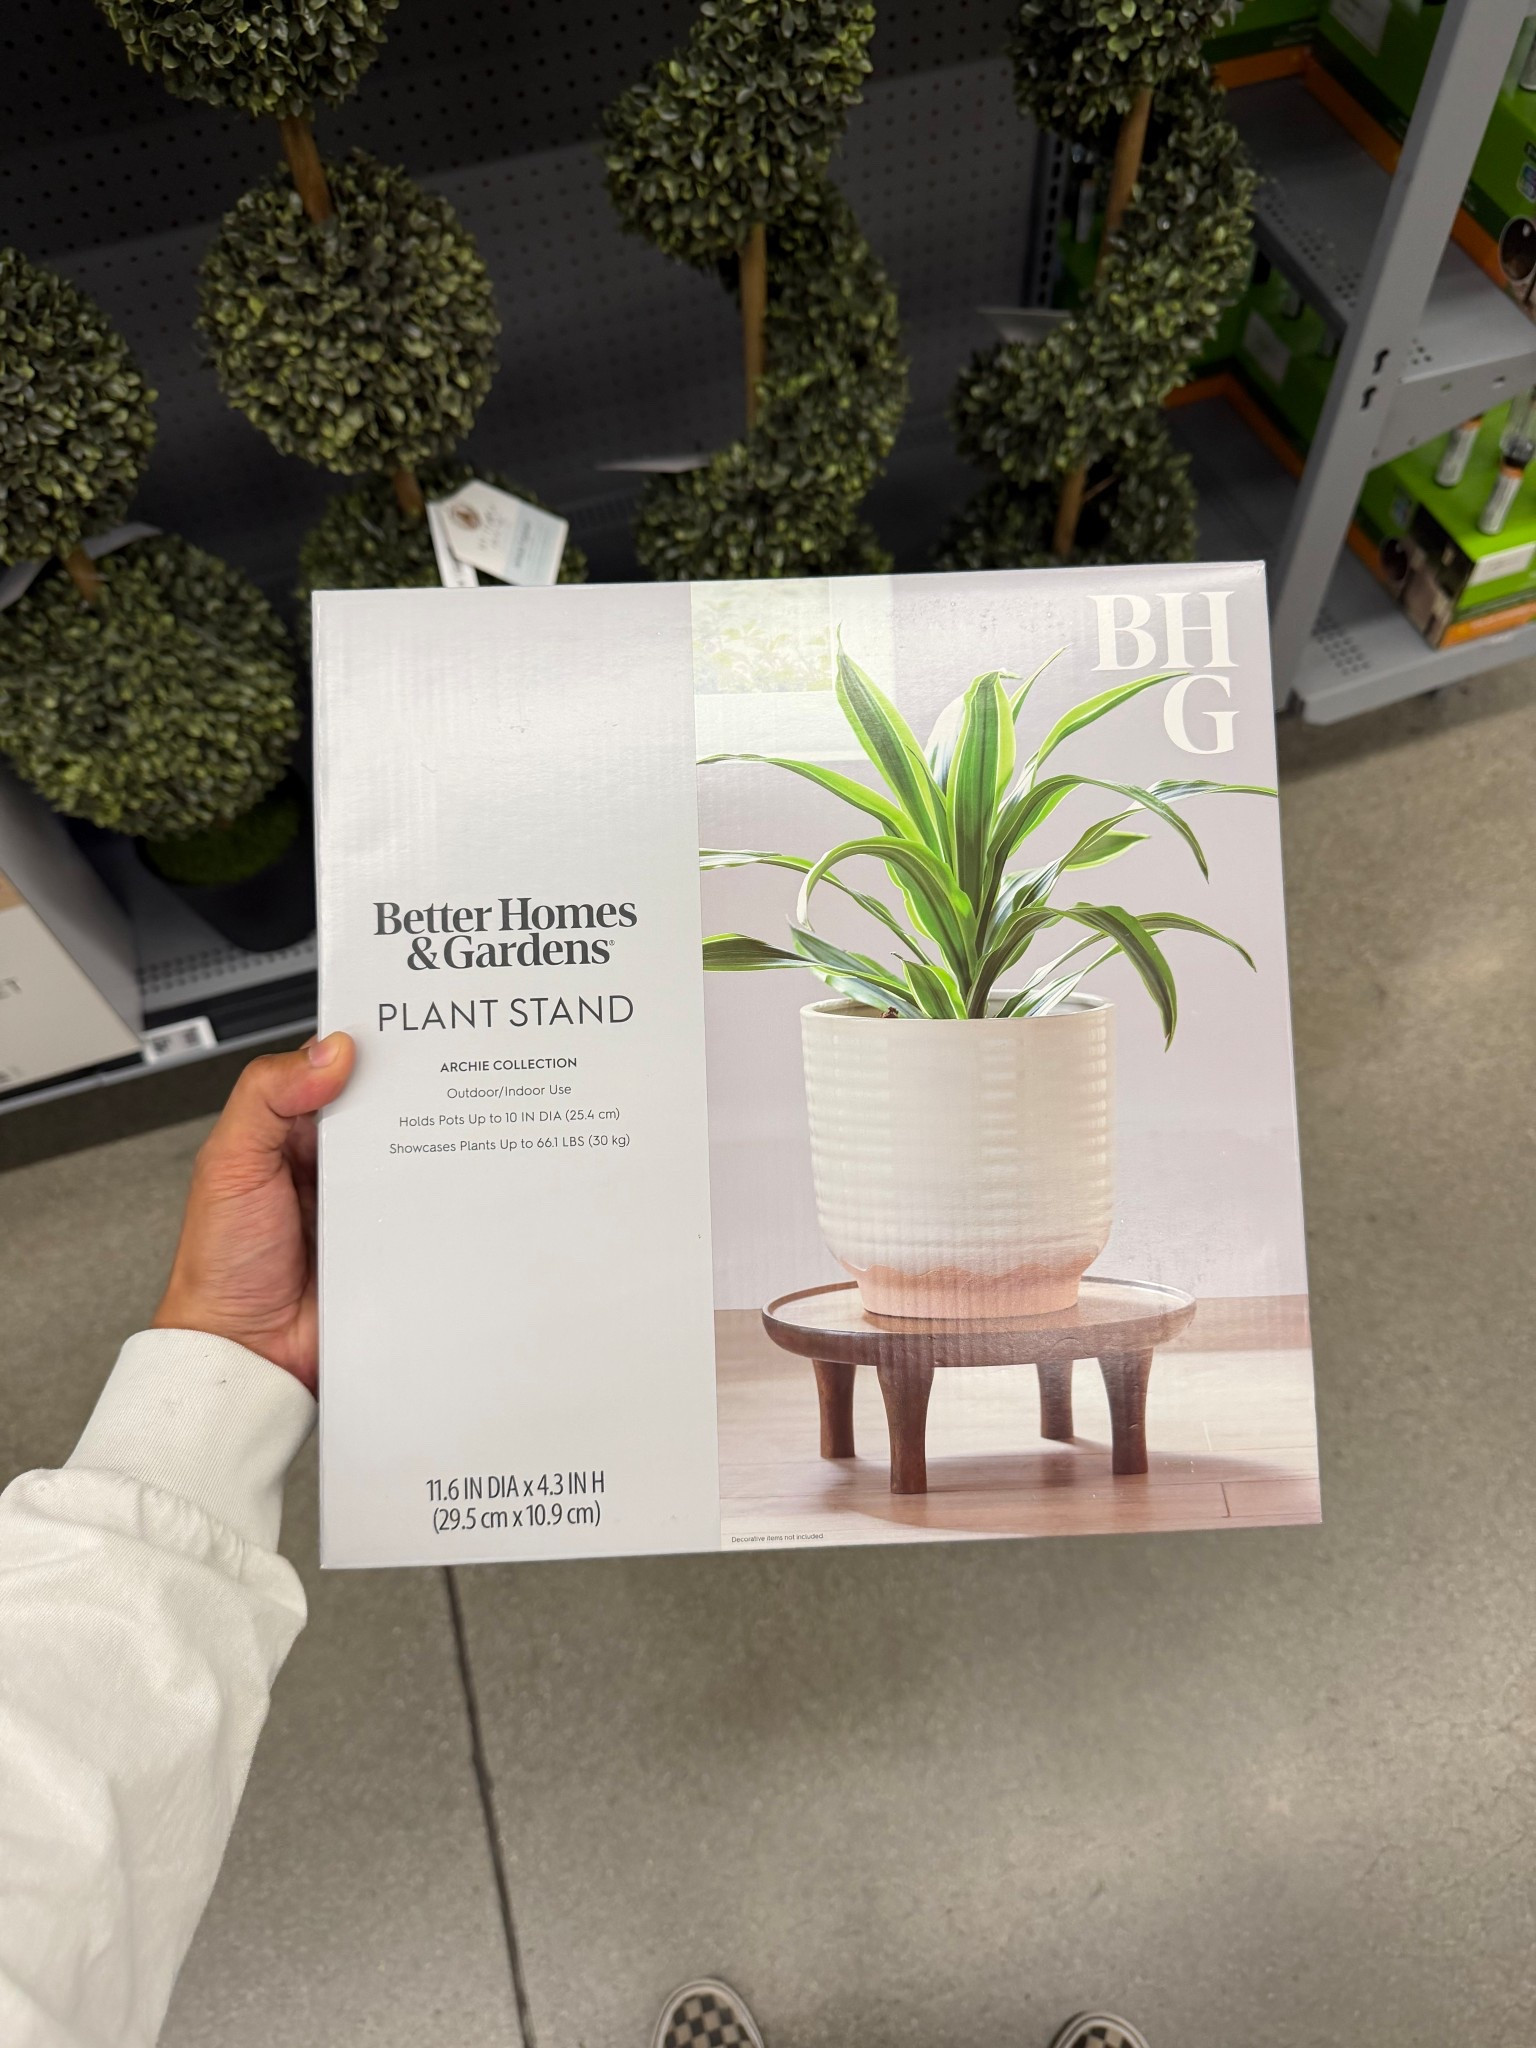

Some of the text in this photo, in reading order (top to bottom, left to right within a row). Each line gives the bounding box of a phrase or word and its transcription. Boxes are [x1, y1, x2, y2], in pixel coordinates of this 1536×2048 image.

[1163, 674, 1240, 755] G
[373, 897, 637, 936] Better Homes
[379, 995, 634, 1031] PLANT STAND
[440, 1058, 577, 1073] ARCHIE COLLECTION
[447, 1085, 572, 1099] Outdoor/Indoor Use
[399, 1108, 620, 1127] Holds Pots Up to 10 IN DIA (25.4 cm)
[390, 1134, 630, 1154] Showcases Plants Up to 66.1 LBS (30 kg)
[427, 1471, 605, 1501] 11.6 IN DIA x 4.3 IN H
[433, 1500, 601, 1535] (29.5 cm x 10.9 cm)
